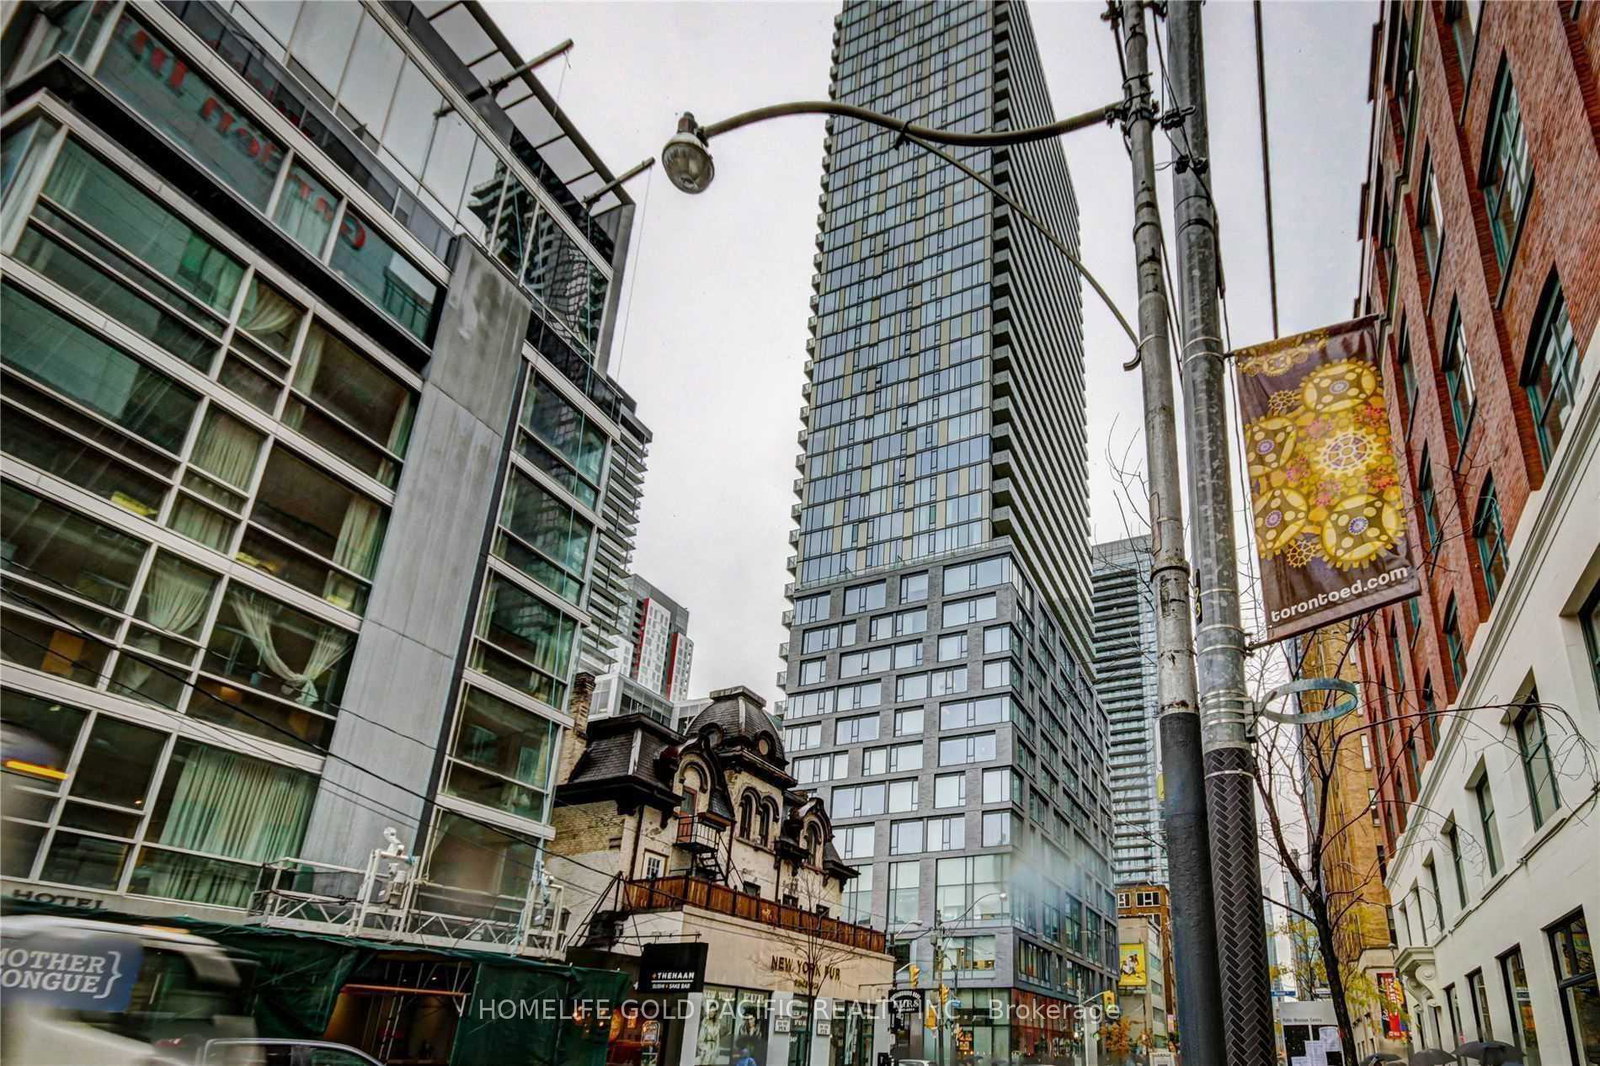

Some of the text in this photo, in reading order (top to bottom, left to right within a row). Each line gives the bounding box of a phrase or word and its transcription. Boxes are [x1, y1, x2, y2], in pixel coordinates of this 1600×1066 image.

[1271, 566, 1409, 622] torontoed.com
[12, 889, 105, 911] HOTEL
[771, 955, 793, 973] NEW
[824, 965, 841, 981] FUR
[0, 969, 101, 993] ONGUE
